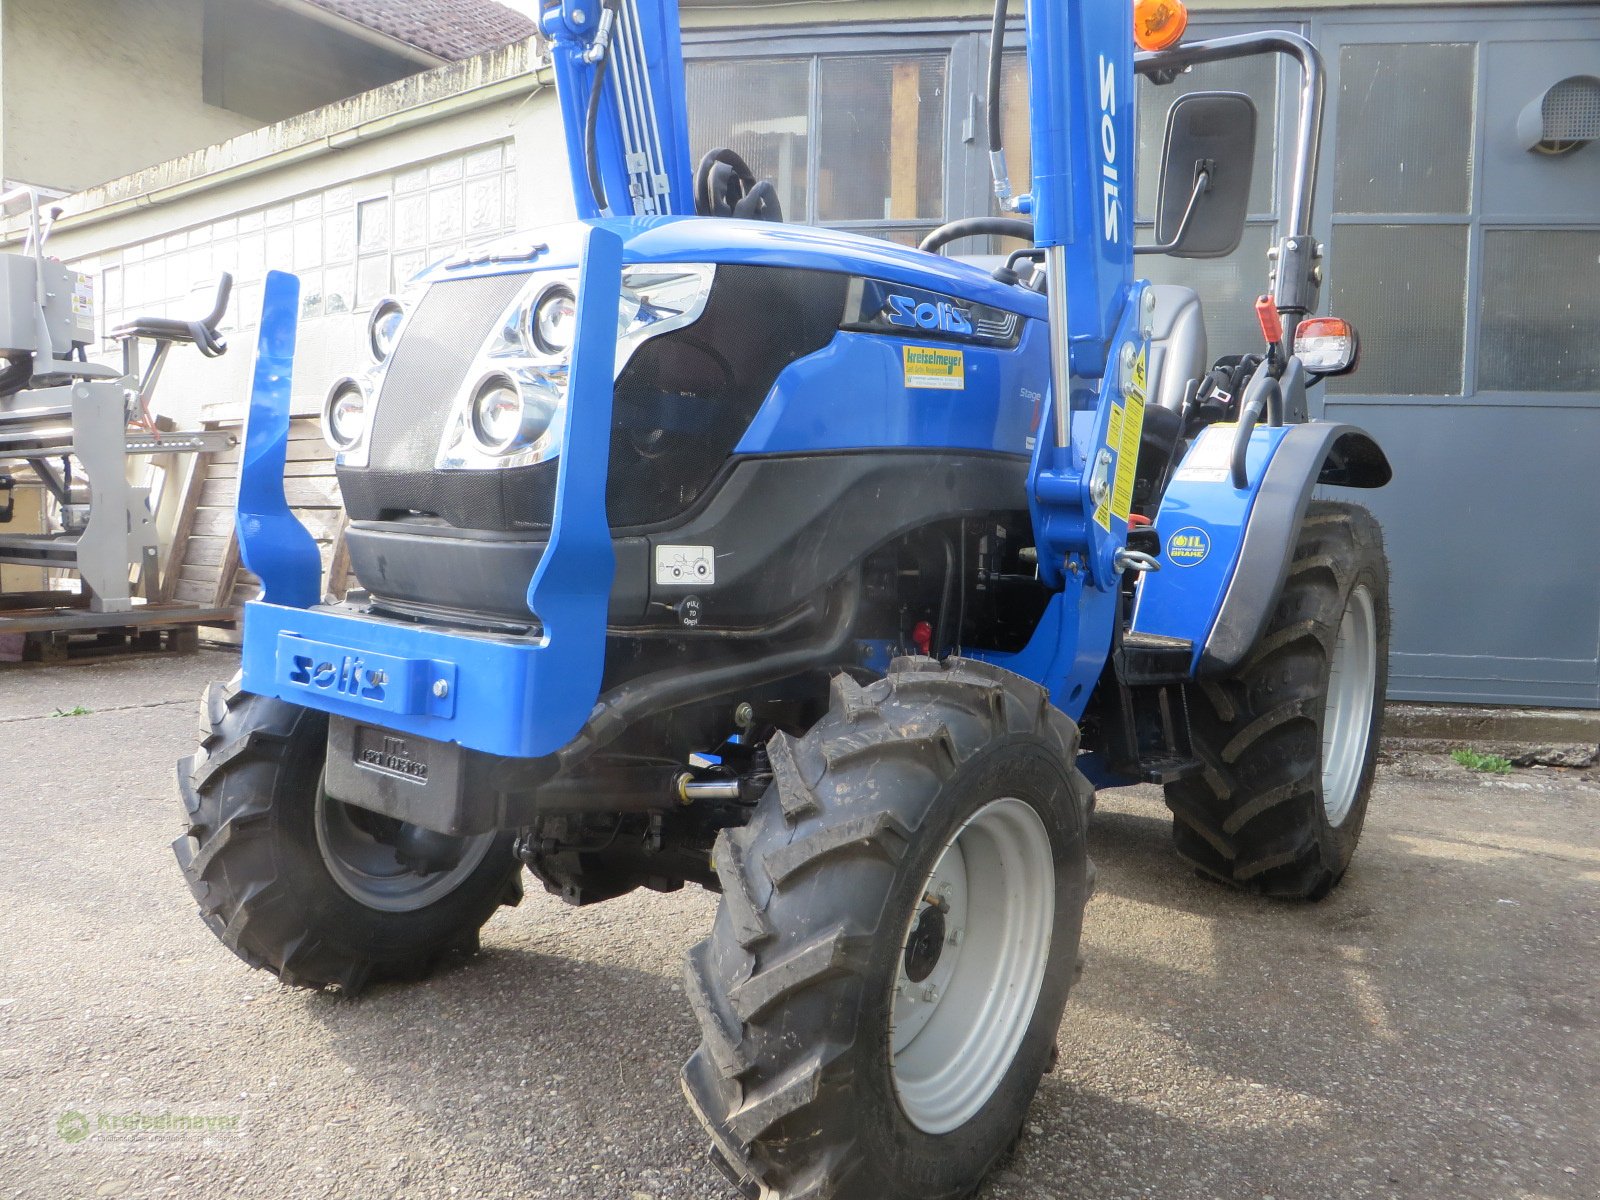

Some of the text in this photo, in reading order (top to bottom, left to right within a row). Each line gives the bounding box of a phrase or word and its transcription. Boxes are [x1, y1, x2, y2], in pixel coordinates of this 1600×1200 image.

[1020, 387, 1041, 401] Stage
[1173, 535, 1205, 547] OIL
[686, 600, 700, 609] PULL
